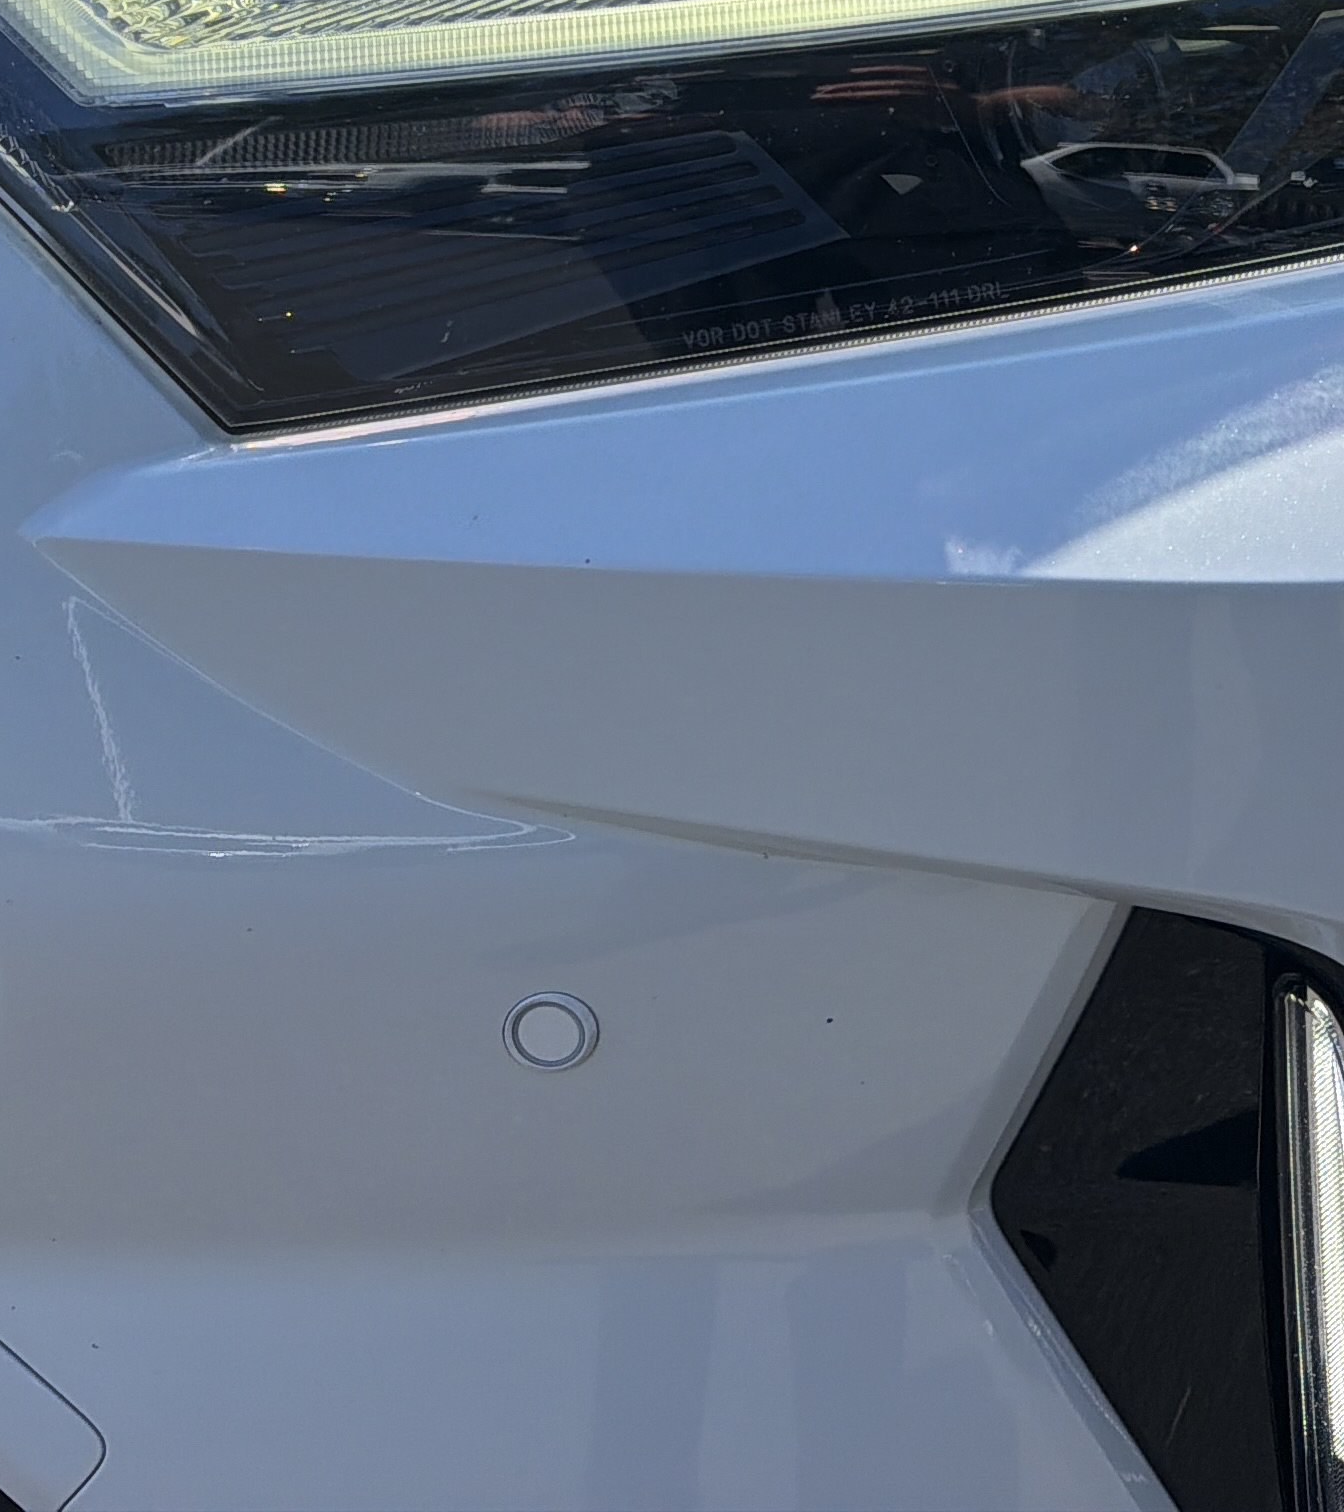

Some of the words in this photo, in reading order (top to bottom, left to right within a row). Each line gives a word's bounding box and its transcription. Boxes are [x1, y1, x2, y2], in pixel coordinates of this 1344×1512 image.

[732, 317, 773, 343] DOT
[781, 300, 877, 335] STANLEY
[967, 281, 1011, 302] DRL
